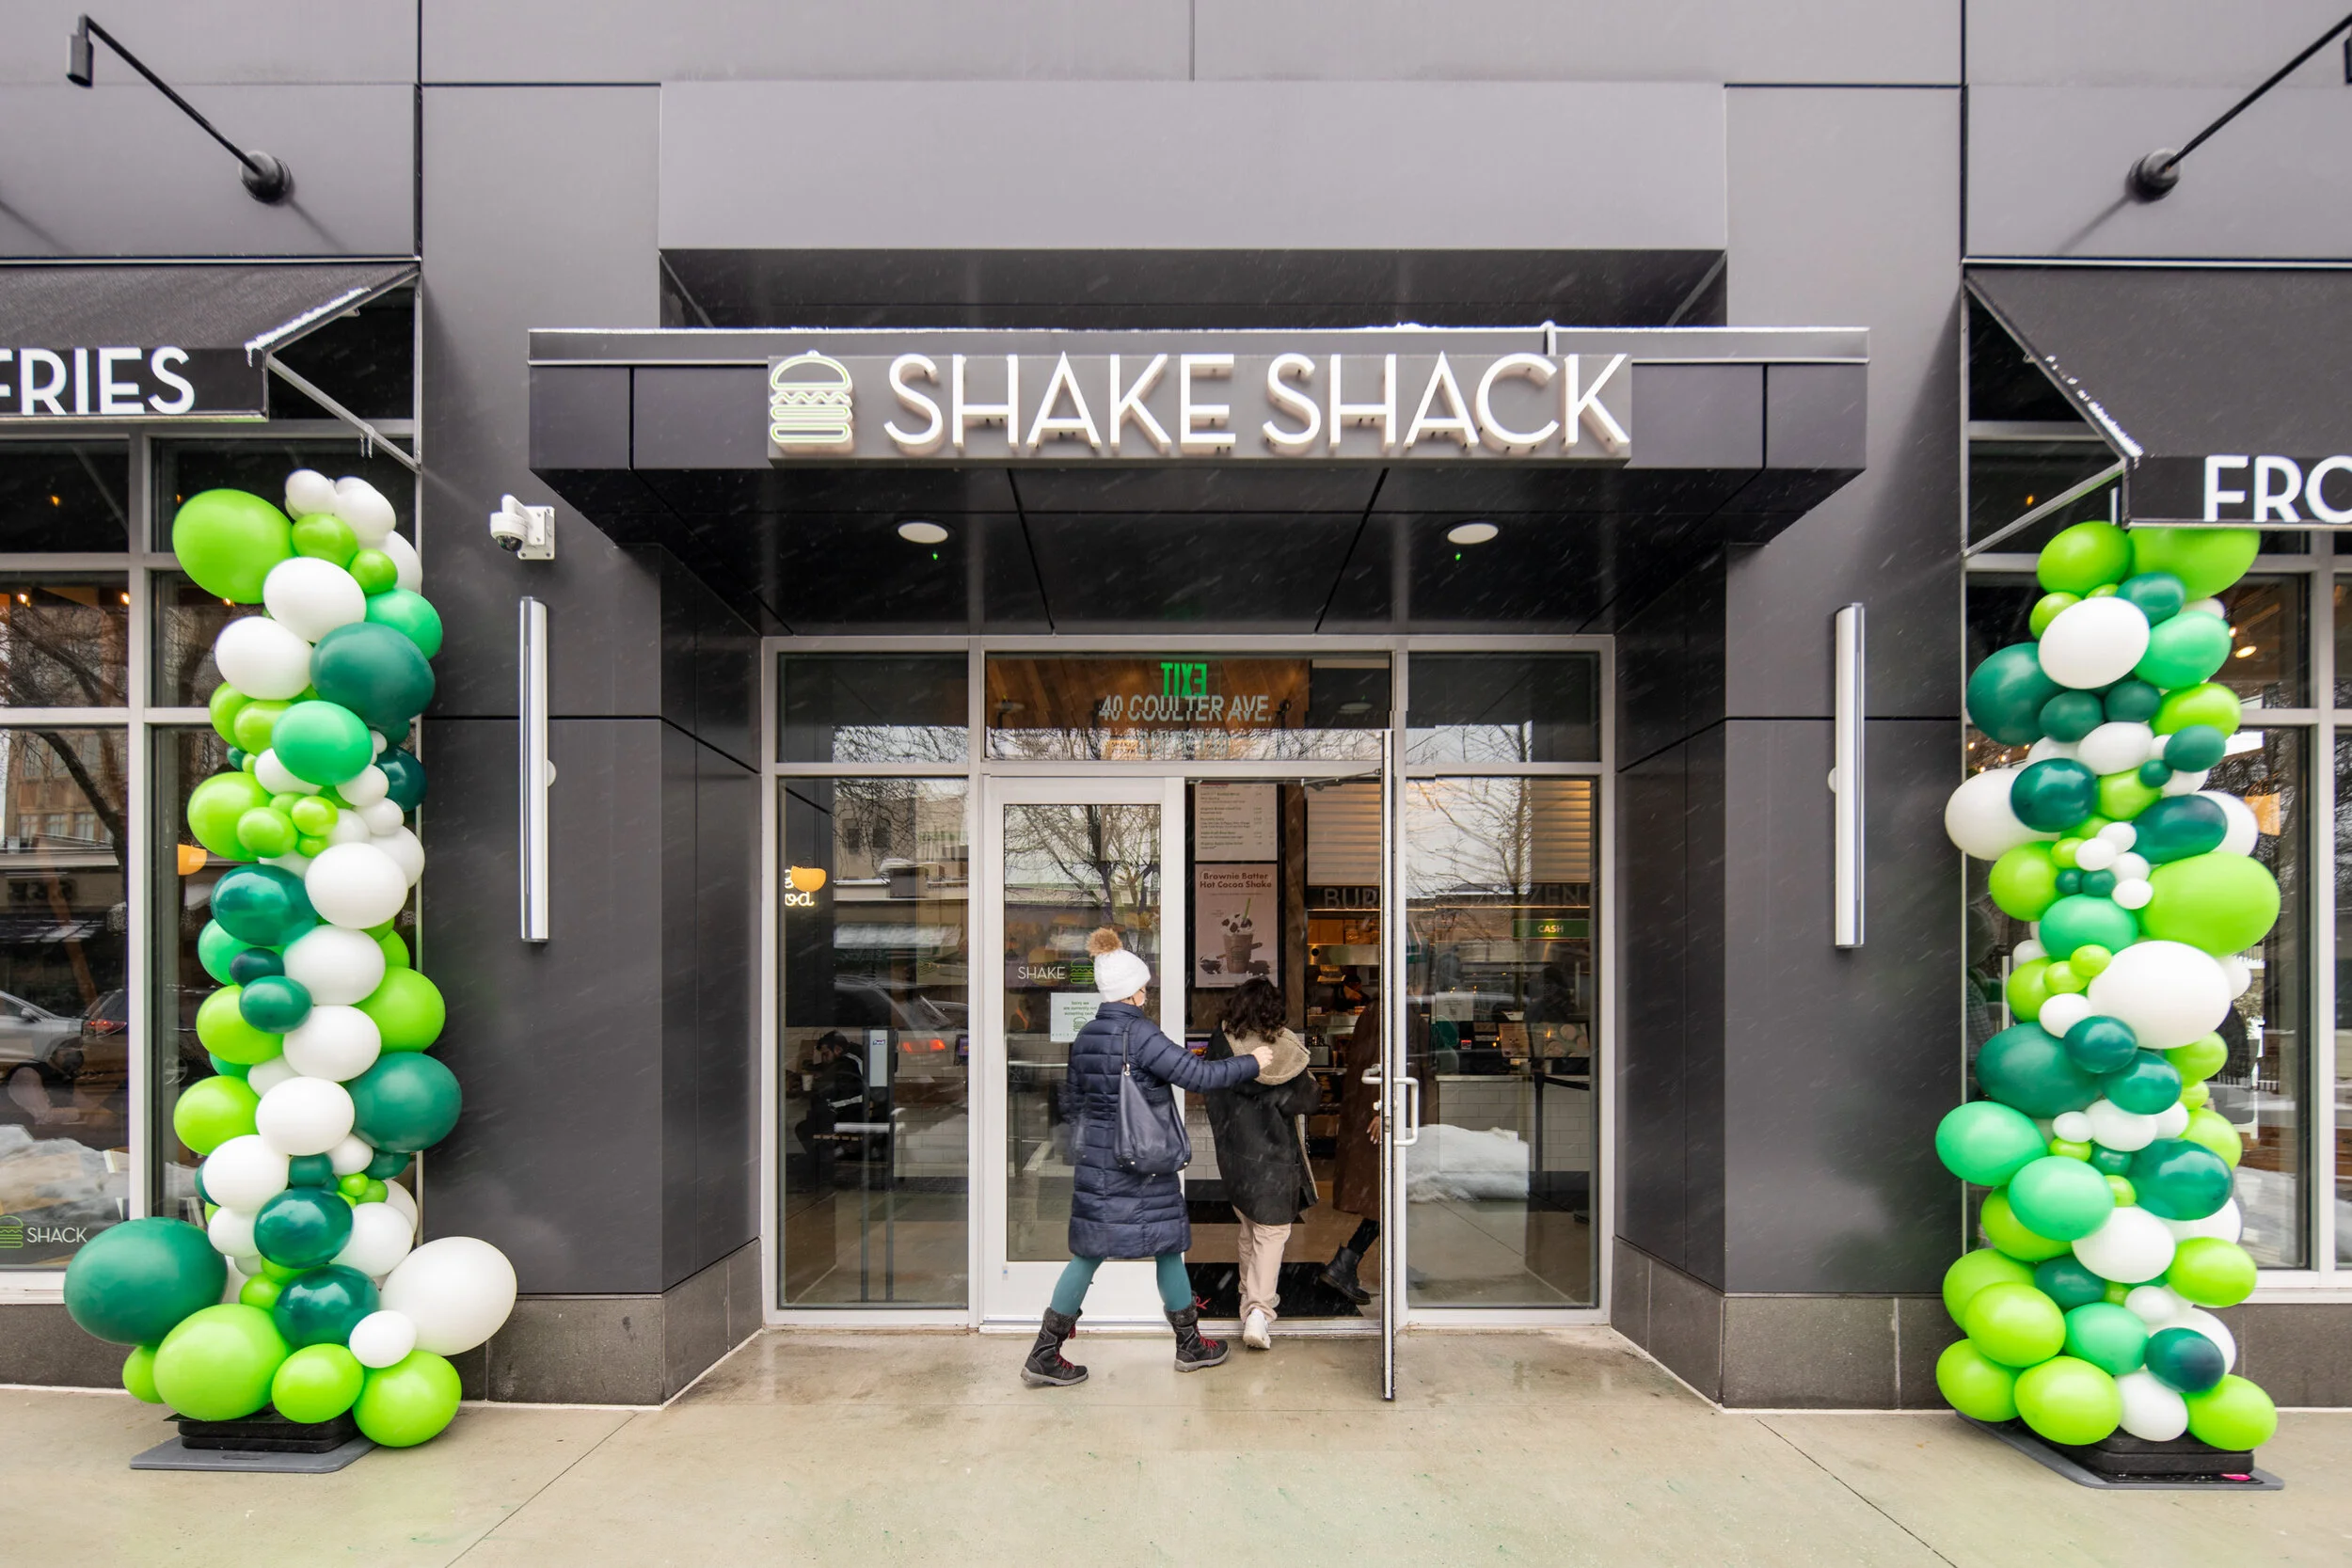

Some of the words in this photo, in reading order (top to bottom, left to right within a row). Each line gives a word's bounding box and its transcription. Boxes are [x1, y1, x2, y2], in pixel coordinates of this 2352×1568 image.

[883, 351, 1236, 447] SHAKE
[1263, 351, 1630, 447] SHACK
[2203, 454, 2352, 523] FRO
[1099, 694, 1123, 721] 40
[1127, 694, 1224, 721] COULTER
[1227, 694, 1271, 721] AVE.
[1537, 925, 1564, 933] CASH
[1018, 967, 1066, 979] SHAKE
[26, 1227, 87, 1243] SHACK
